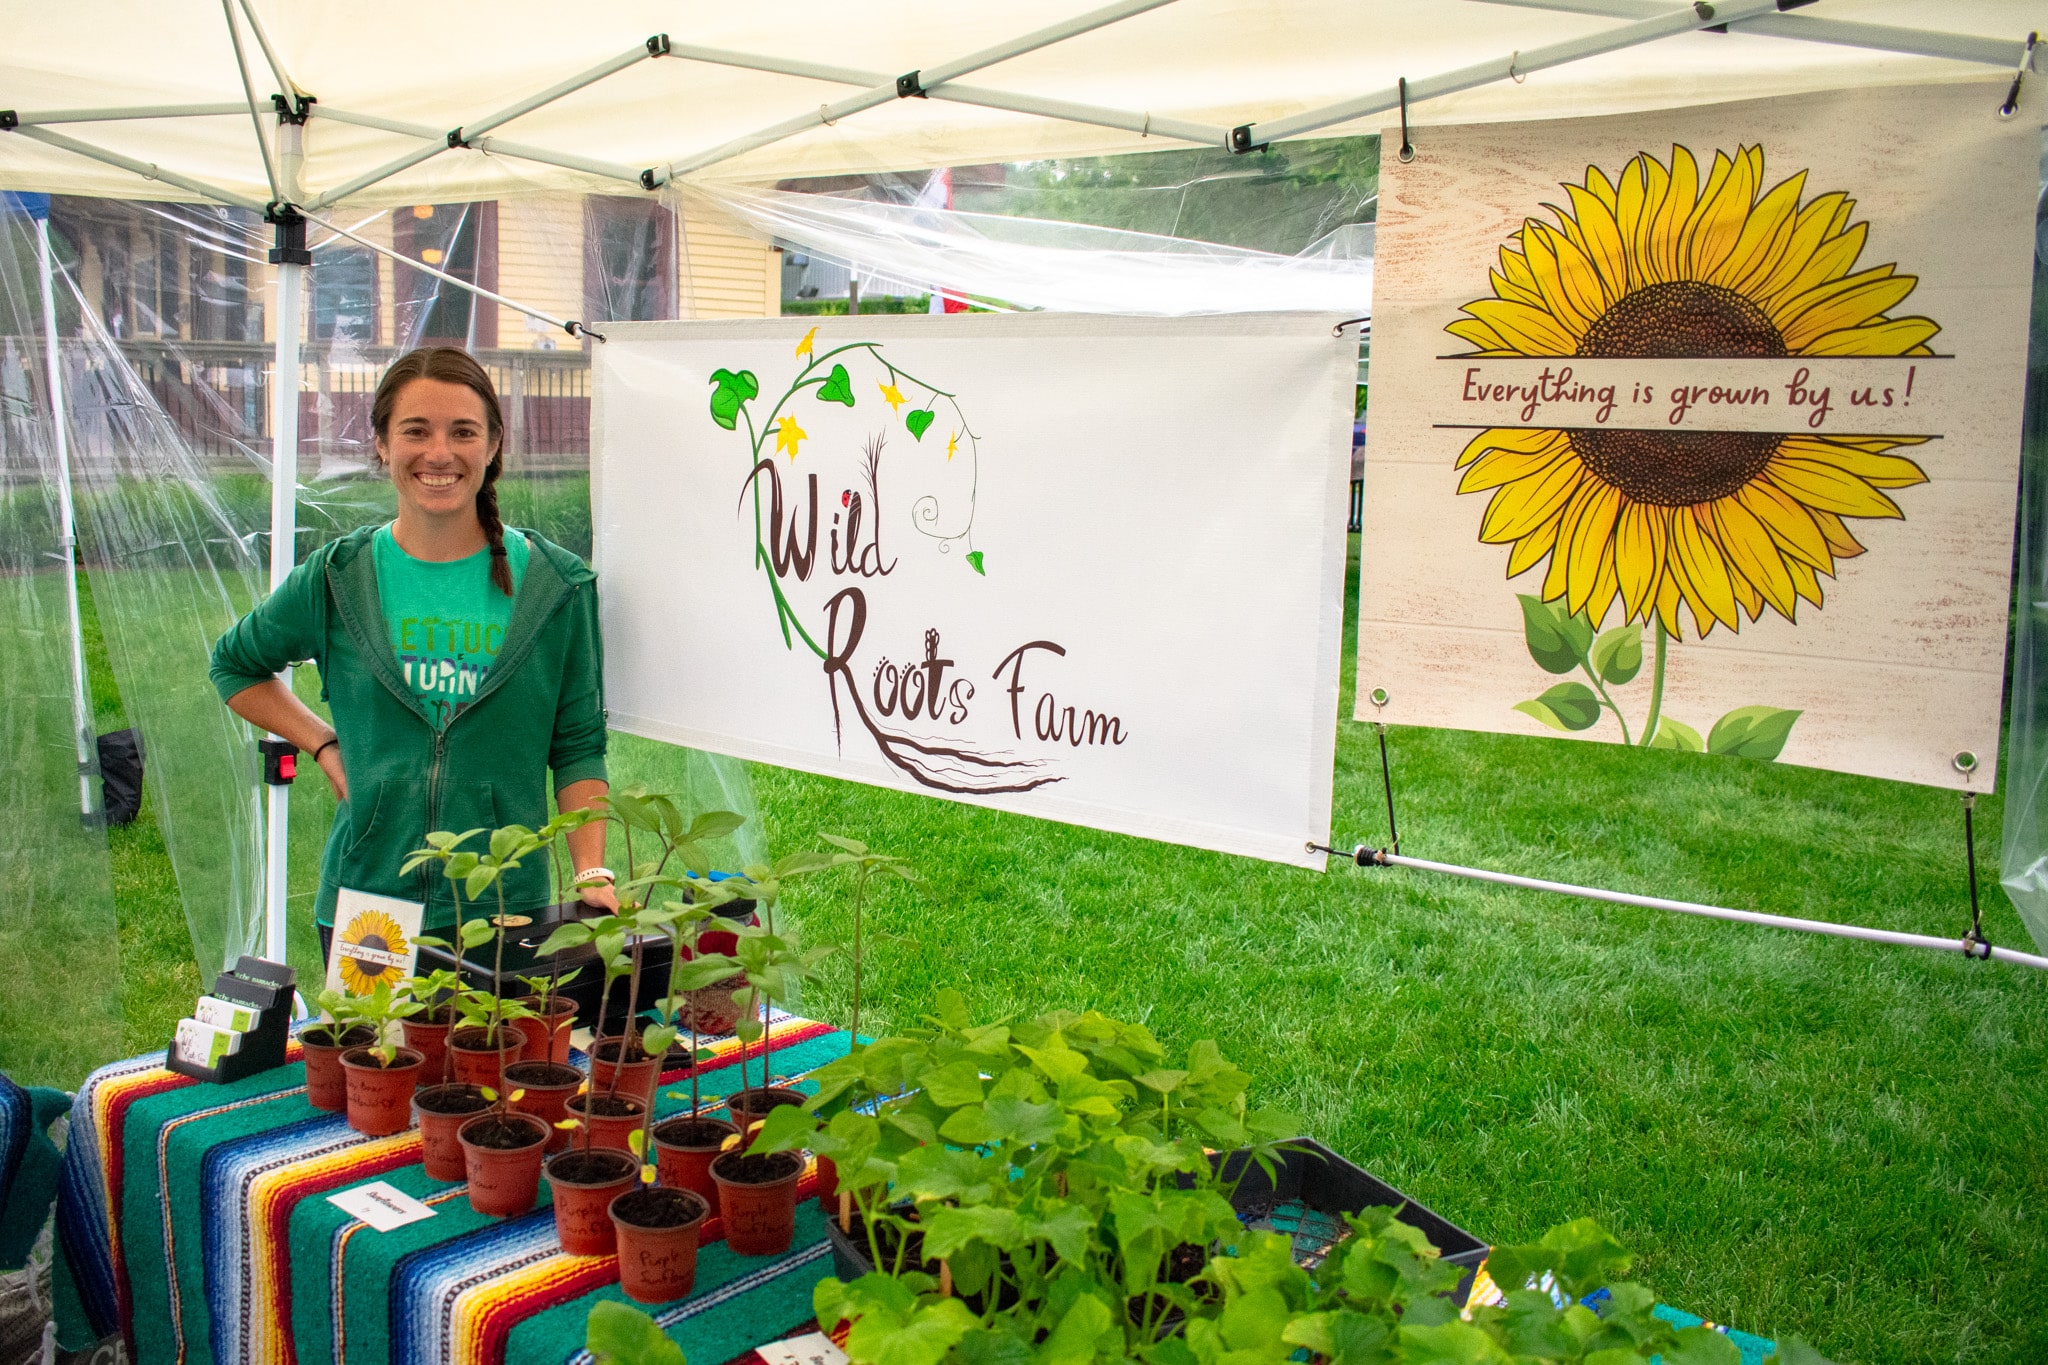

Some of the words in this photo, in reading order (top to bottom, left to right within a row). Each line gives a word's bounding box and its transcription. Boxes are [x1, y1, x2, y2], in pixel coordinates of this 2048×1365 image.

[1463, 366, 1618, 423] Everything
[1632, 382, 1654, 404] is
[1668, 385, 1770, 425] grown
[1785, 367, 1834, 428] by
[1850, 365, 1917, 408] us!
[738, 427, 899, 582] Wild
[392, 616, 509, 656] ETTUC
[992, 640, 1129, 748] Farm
